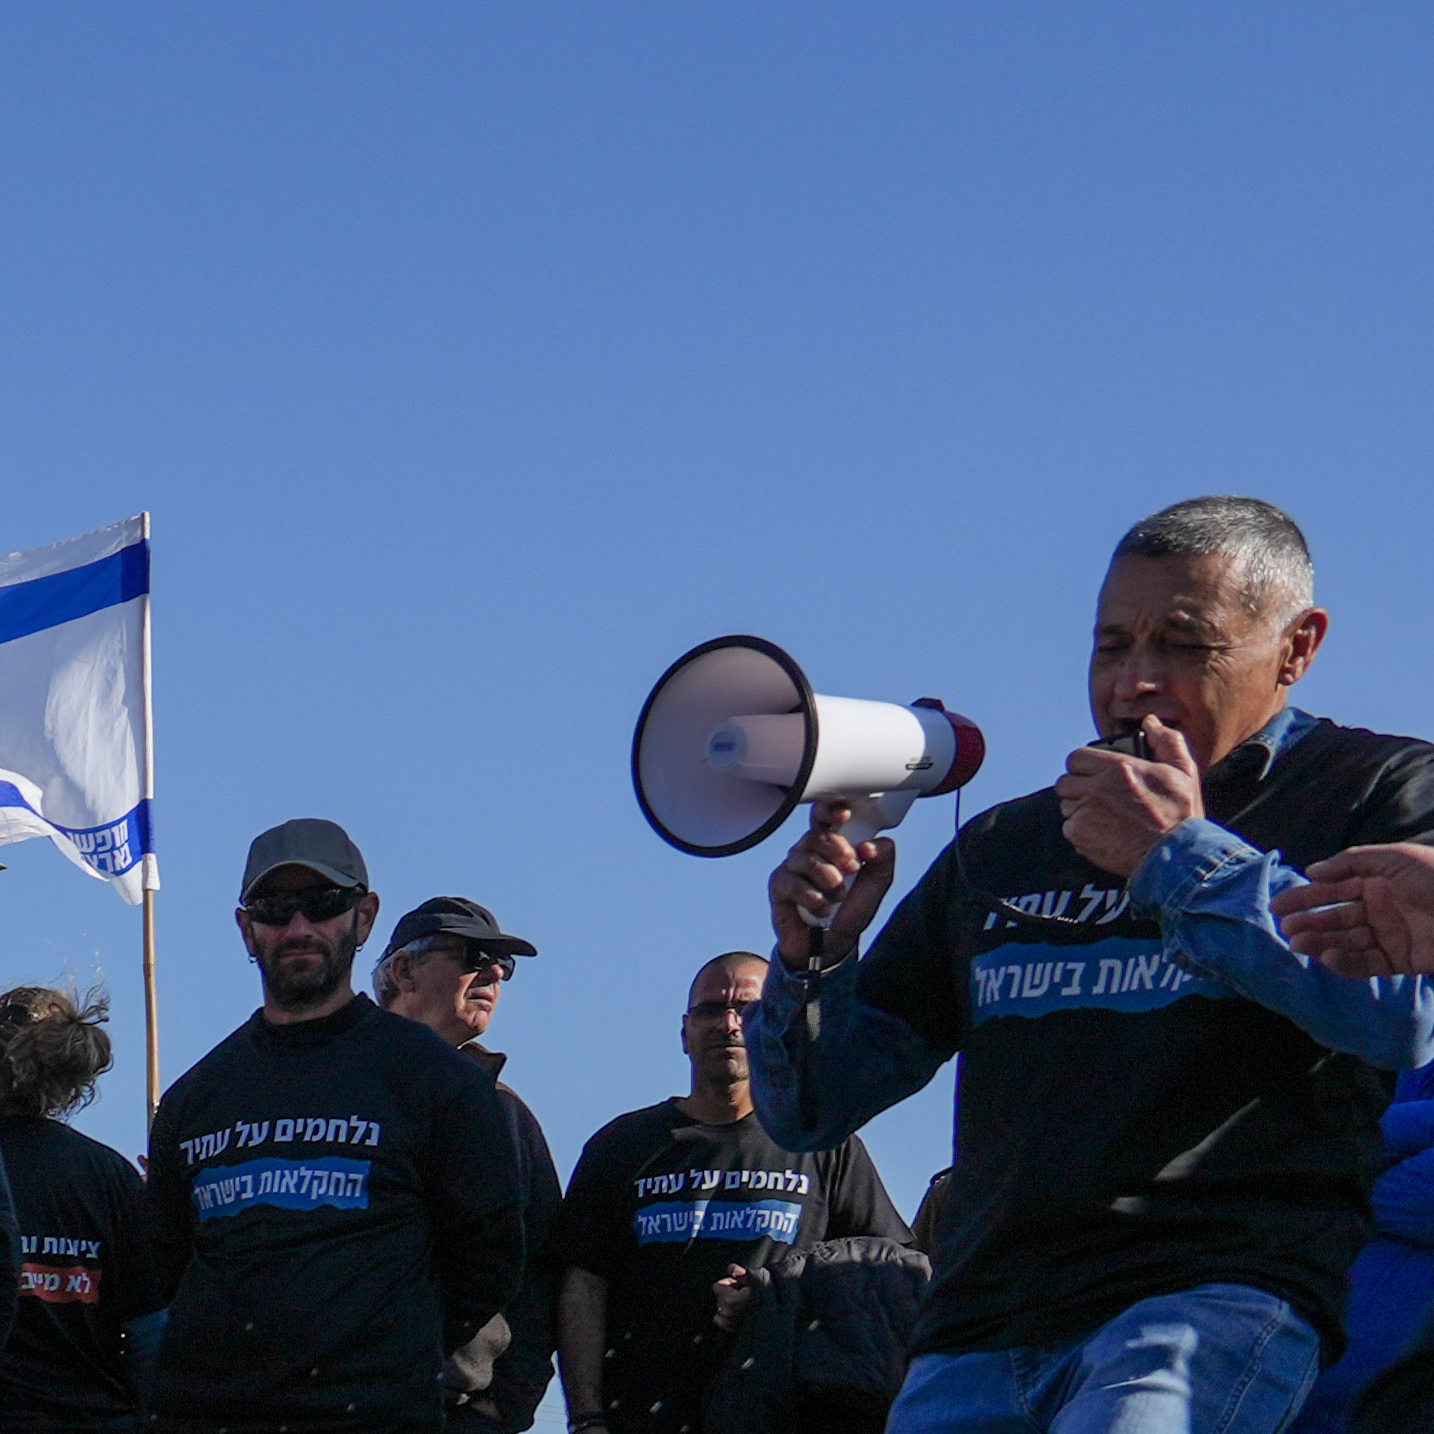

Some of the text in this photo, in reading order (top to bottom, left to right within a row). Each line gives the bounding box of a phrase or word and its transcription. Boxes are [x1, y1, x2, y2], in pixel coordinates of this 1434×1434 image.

[974, 960, 1088, 1008] בישראל
[179, 1114, 381, 1166] נלחמים על עתיד
[257, 1166, 365, 1201] החקלאות
[634, 1168, 810, 1198] נלחמים על עתיד
[637, 1206, 800, 1237] החקלאות בישראל
[42, 1236, 102, 1259] ציונות
[65, 1272, 91, 1294] לא
